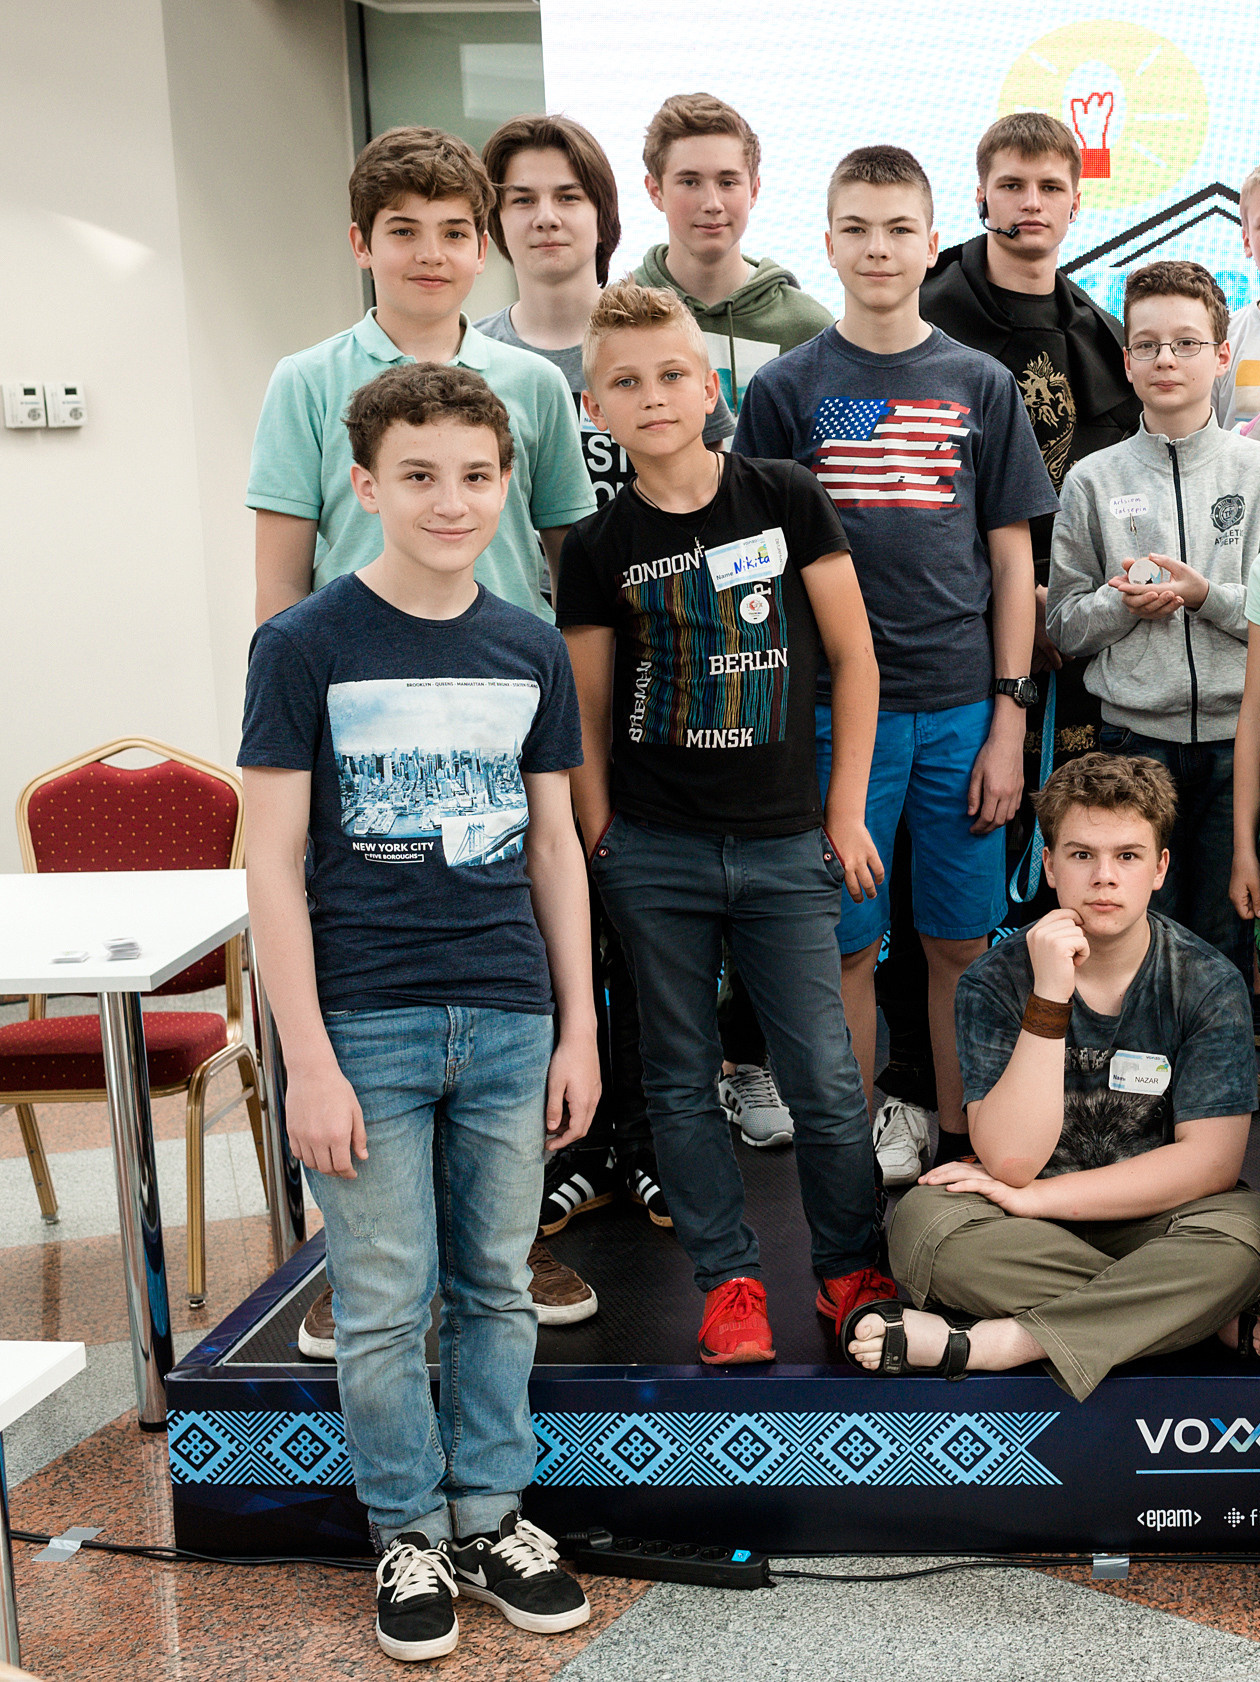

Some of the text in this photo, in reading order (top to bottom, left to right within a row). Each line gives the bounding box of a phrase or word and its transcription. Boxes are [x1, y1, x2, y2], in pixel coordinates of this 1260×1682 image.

[733, 551, 770, 575] Nikita
[716, 571, 734, 580] Name
[708, 648, 788, 676] BERLIN
[685, 727, 754, 749] MINSK
[352, 842, 434, 852] NEW YORK CITY
[1134, 1076, 1159, 1084] NAZAR
